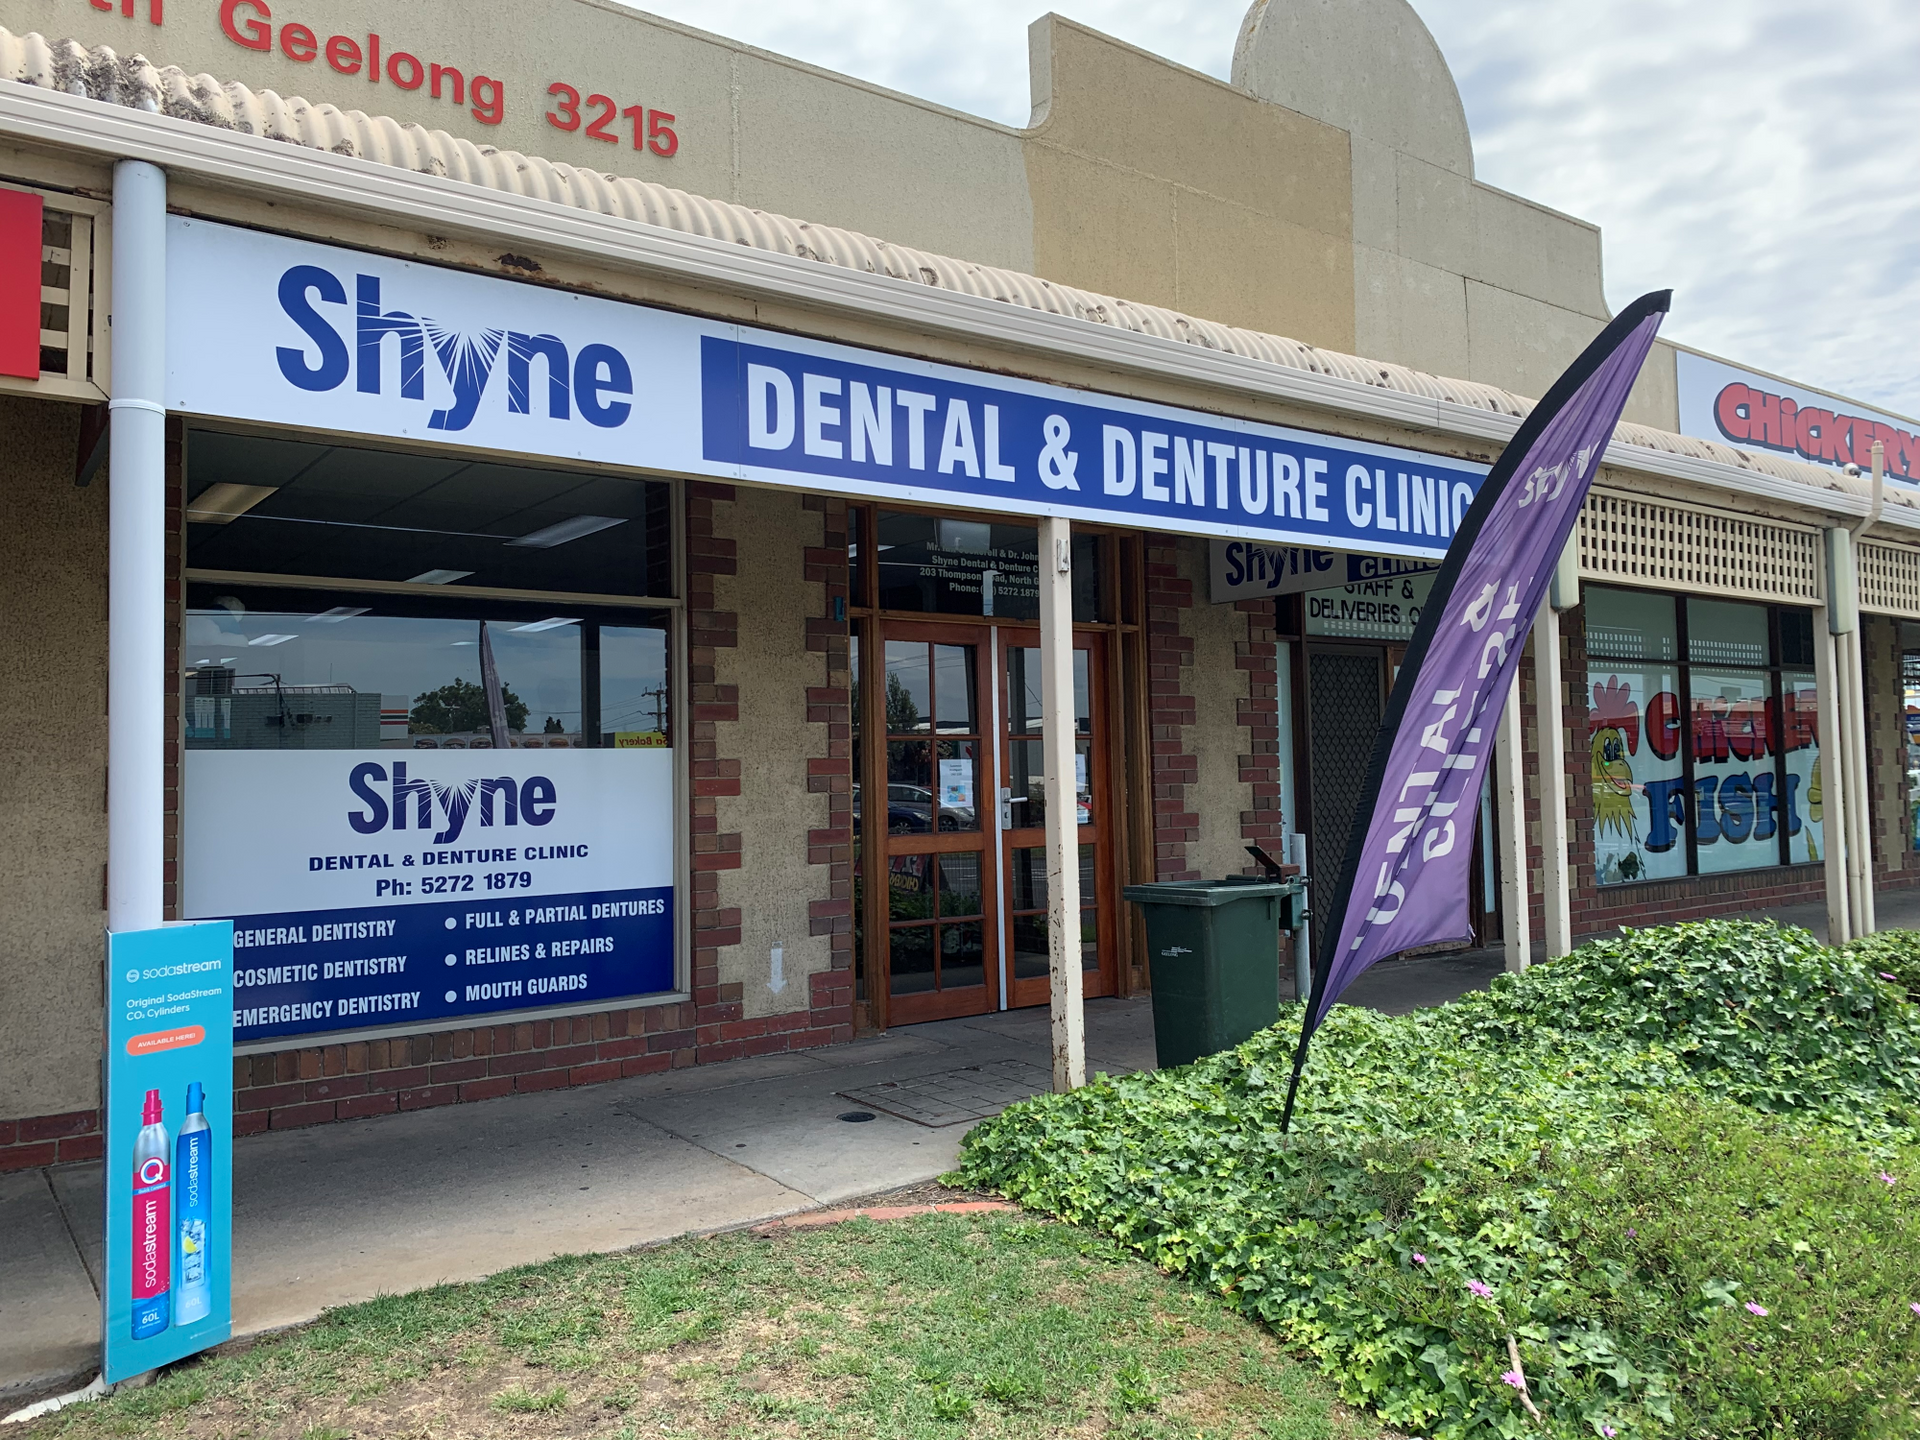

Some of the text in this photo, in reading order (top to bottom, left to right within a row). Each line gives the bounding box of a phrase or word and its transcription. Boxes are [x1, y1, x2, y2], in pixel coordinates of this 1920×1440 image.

[220, 0, 679, 158] Geelong 3215
[276, 265, 634, 432] Shyne
[746, 363, 1015, 482] DENTAL
[1038, 414, 1081, 492] &
[1103, 424, 1330, 523] DENTURE
[926, 542, 940, 552] Mr.
[999, 549, 1007, 558] &
[1008, 550, 1020, 560] Dr.
[931, 555, 959, 567] Shyne
[960, 558, 989, 569] Dental
[990, 561, 997, 569] &
[998, 561, 1032, 573] Denture
[1225, 541, 1334, 590] Shyne
[920, 567, 937, 577] 203
[938, 569, 982, 582] Thompson
[991, 574, 1008, 585] oad,
[1009, 575, 1032, 585] North
[949, 582, 979, 593] Phone:
[998, 586, 1019, 596] 5272
[1020, 588, 1040, 598] 1879
[1401, 579, 1414, 600] &
[1310, 597, 1401, 625] DELIVERIES
[347, 760, 557, 844] Shyne
[1643, 771, 1803, 853] FISH
[309, 844, 590, 871] DENTAL & DENTURE CLINIC
[375, 871, 532, 898] Ph: 5272 1879
[465, 899, 665, 930] FULL & PARTIAL DENTURES
[233, 919, 396, 949] GENERAL DENTISTRY
[465, 936, 614, 966] RELINES & REPAIRS
[142, 959, 222, 980] sodastream
[233, 956, 407, 989] COSMETIC DENTISTRY
[126, 987, 222, 1009] Original SodaStream
[465, 973, 588, 1002] MOUTH GUARDS
[147, 1004, 190, 1019] Cylinders
[233, 992, 421, 1028] EMERGENCY DENTISTRY
[137, 1032, 196, 1048] AVAILABLE HERE!
[187, 1136, 199, 1207] sodastream
[143, 1200, 157, 1289] sodastream
[141, 1311, 160, 1325] 60L
